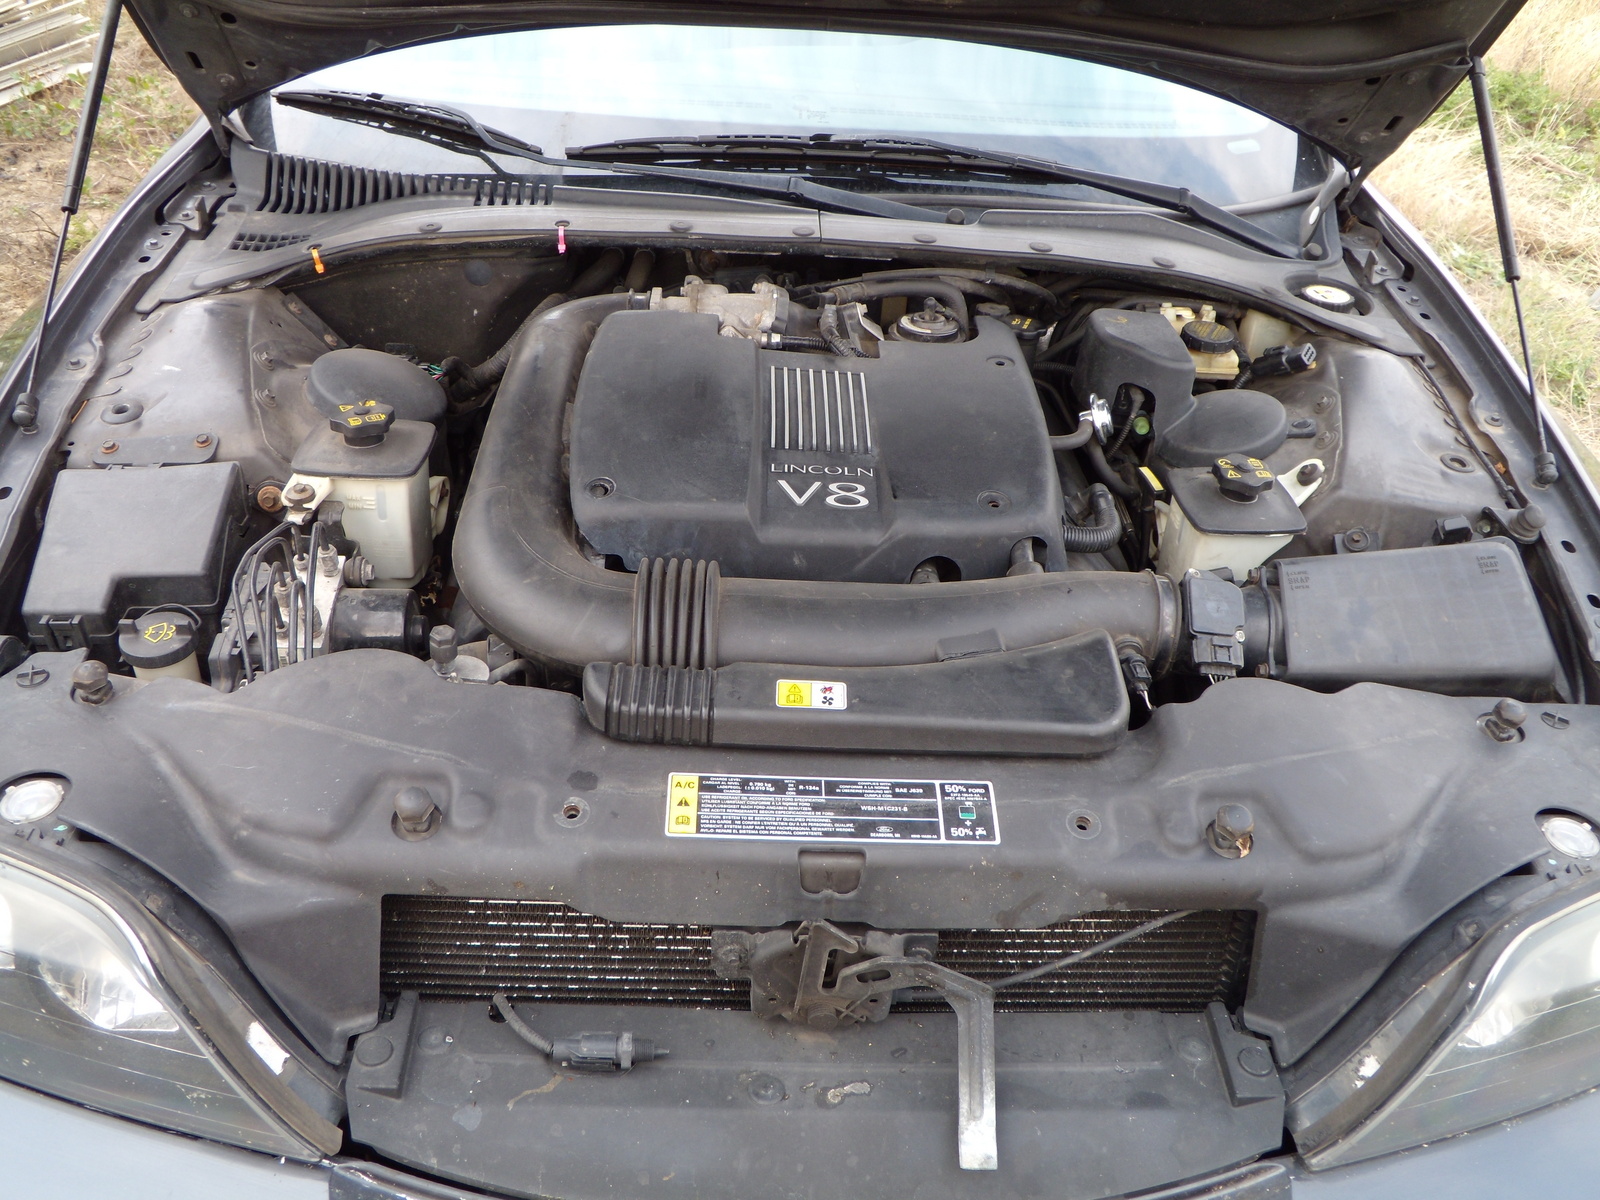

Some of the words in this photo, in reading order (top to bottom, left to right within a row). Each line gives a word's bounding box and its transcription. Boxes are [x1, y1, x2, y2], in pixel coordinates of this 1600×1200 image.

[771, 463, 874, 477] LINCOLN
[776, 479, 870, 508] V8
[951, 828, 973, 836] 50%
